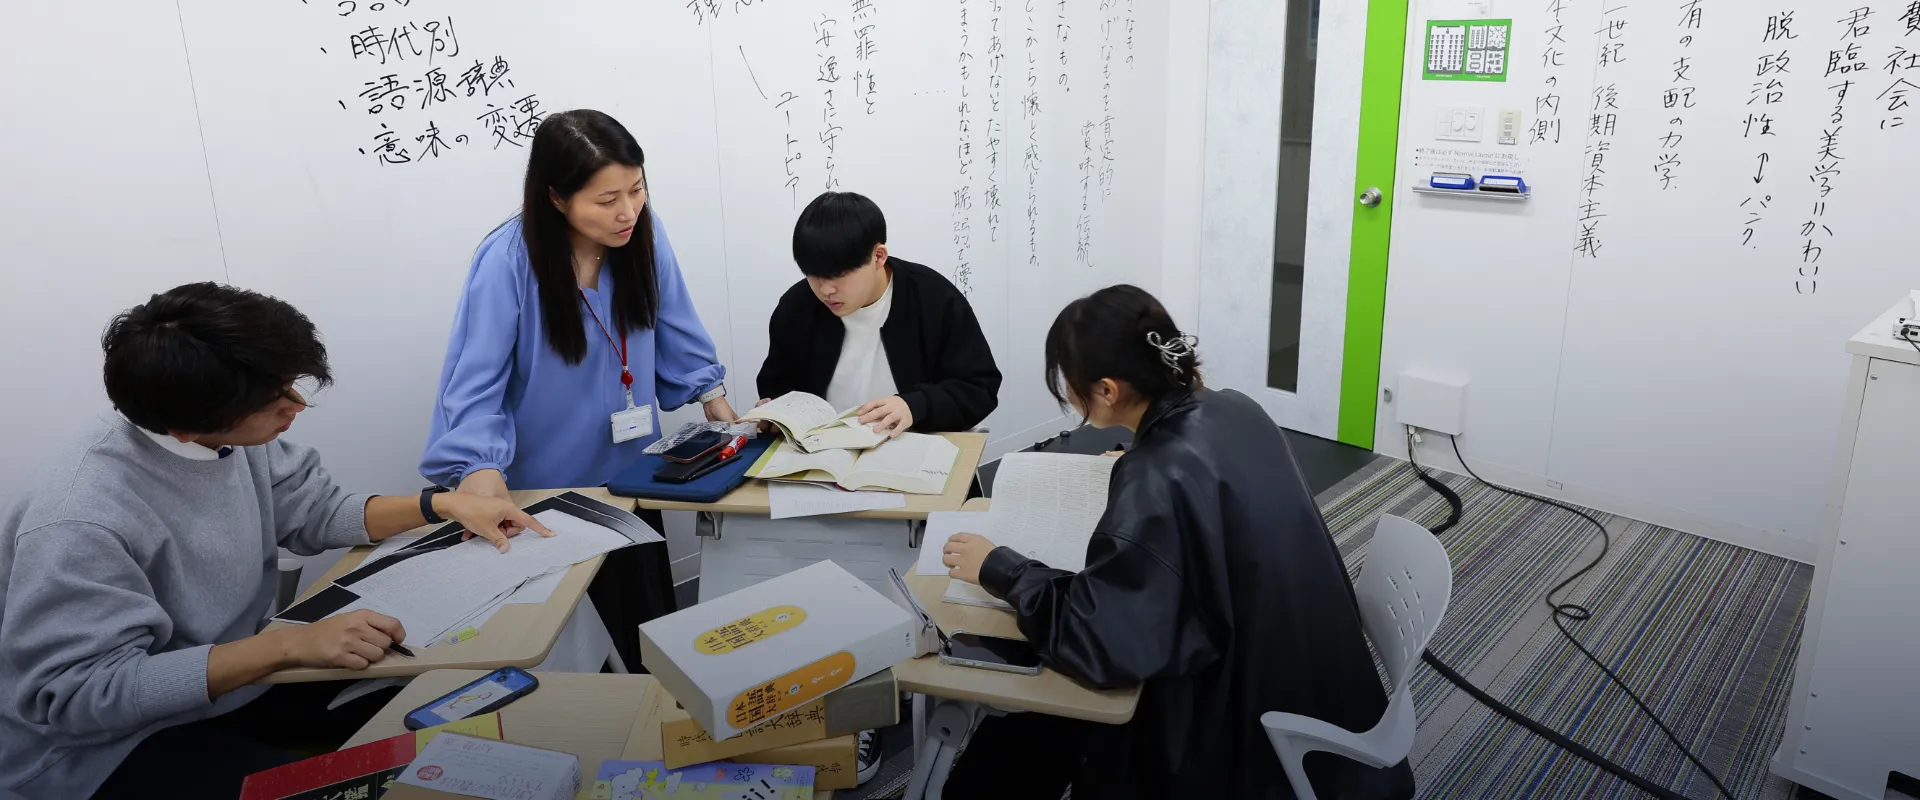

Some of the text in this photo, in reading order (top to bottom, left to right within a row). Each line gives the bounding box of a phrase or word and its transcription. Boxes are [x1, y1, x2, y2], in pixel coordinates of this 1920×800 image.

[351, 16, 459, 65] 時代別
[359, 55, 514, 114] 語源辞典
[1743, 10, 1798, 138] 脱政治性
[775, 92, 802, 210] ユートピア
